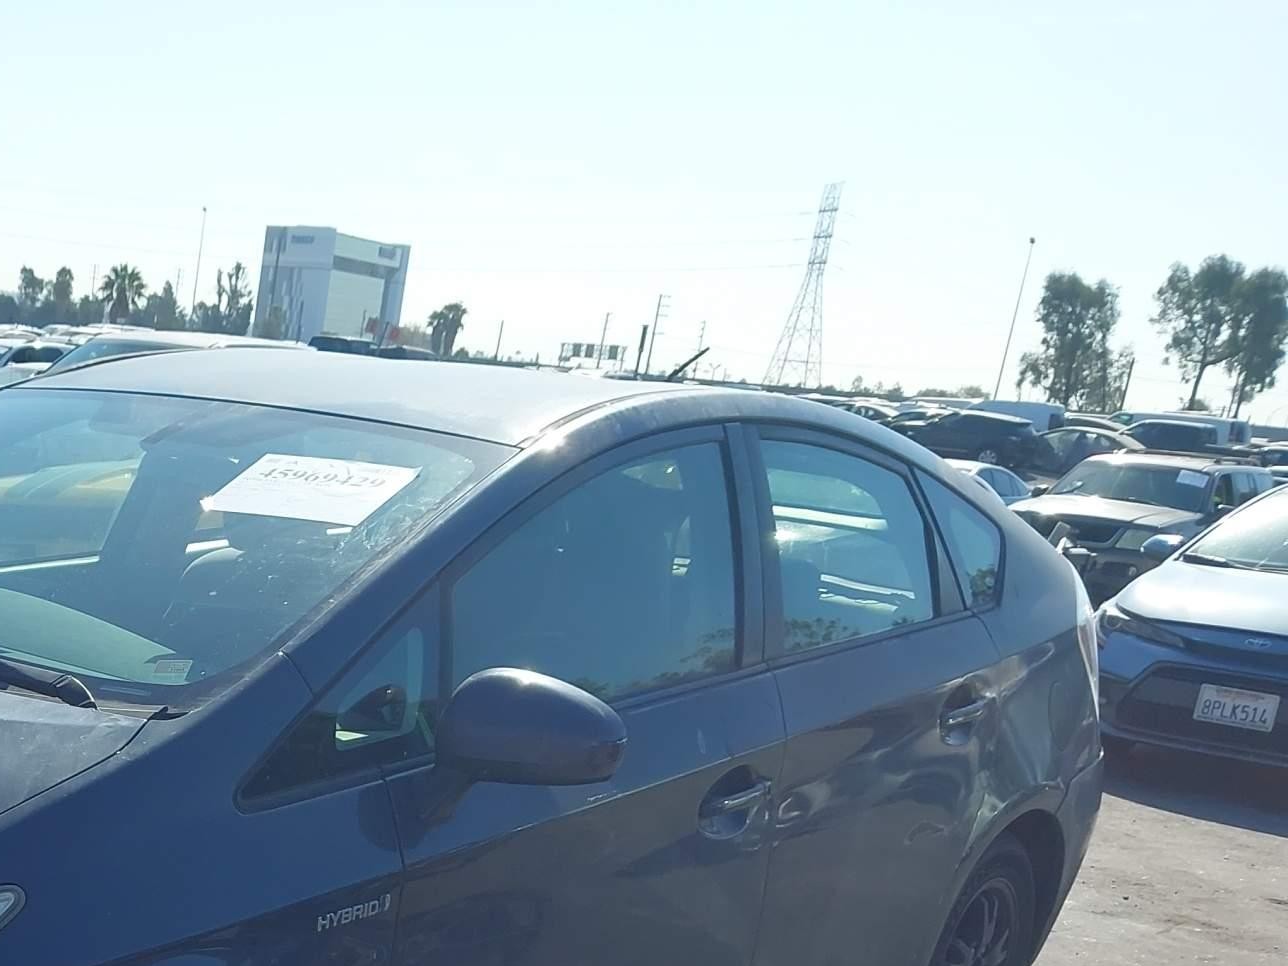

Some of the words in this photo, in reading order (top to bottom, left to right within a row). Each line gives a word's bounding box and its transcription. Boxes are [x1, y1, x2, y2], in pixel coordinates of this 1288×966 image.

[259, 467, 386, 488] 45969429
[1201, 699, 1268, 725] 8PLK514
[317, 900, 379, 932] HYBRID
